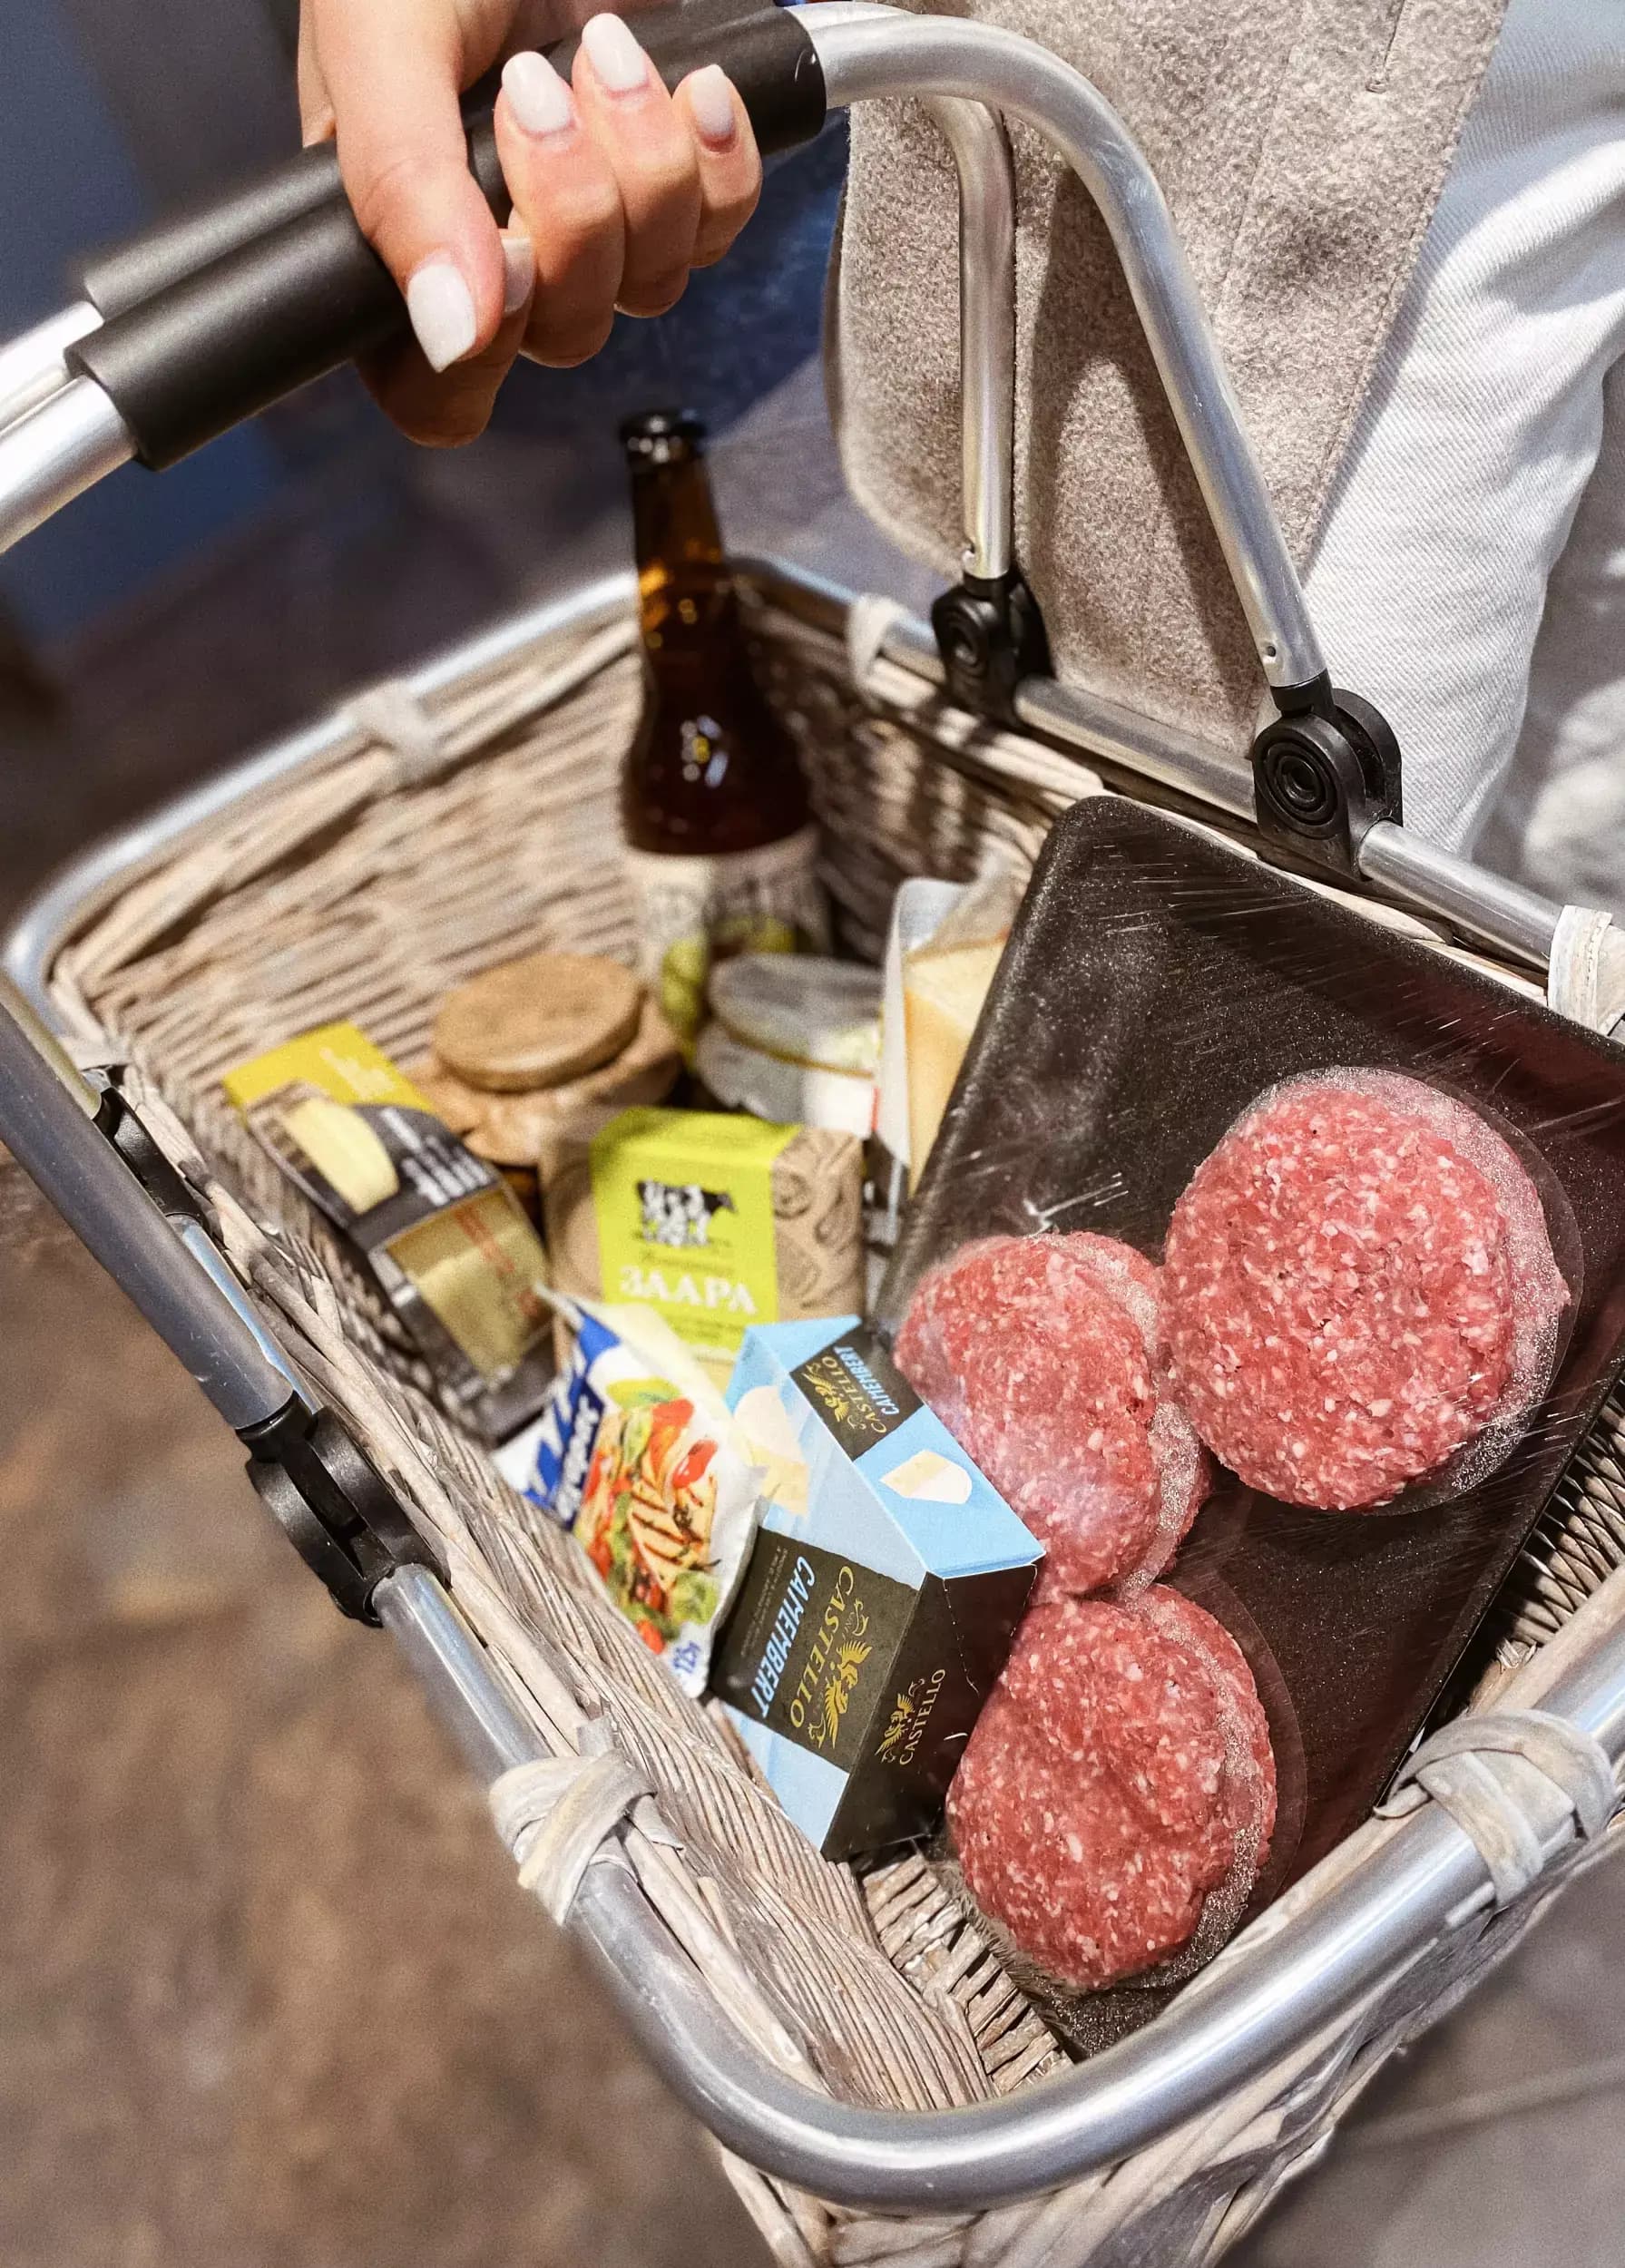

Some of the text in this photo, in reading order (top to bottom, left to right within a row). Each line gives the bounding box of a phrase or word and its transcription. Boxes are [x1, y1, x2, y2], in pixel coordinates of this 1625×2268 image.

[821, 1355, 887, 1433] CASTELLO
[833, 1346, 900, 1415] CAMEMBERT
[750, 1555, 816, 1719] CAMEMBERT
[790, 1565, 855, 1729] CASTELLO
[898, 1668, 946, 1766] CASTELLO
